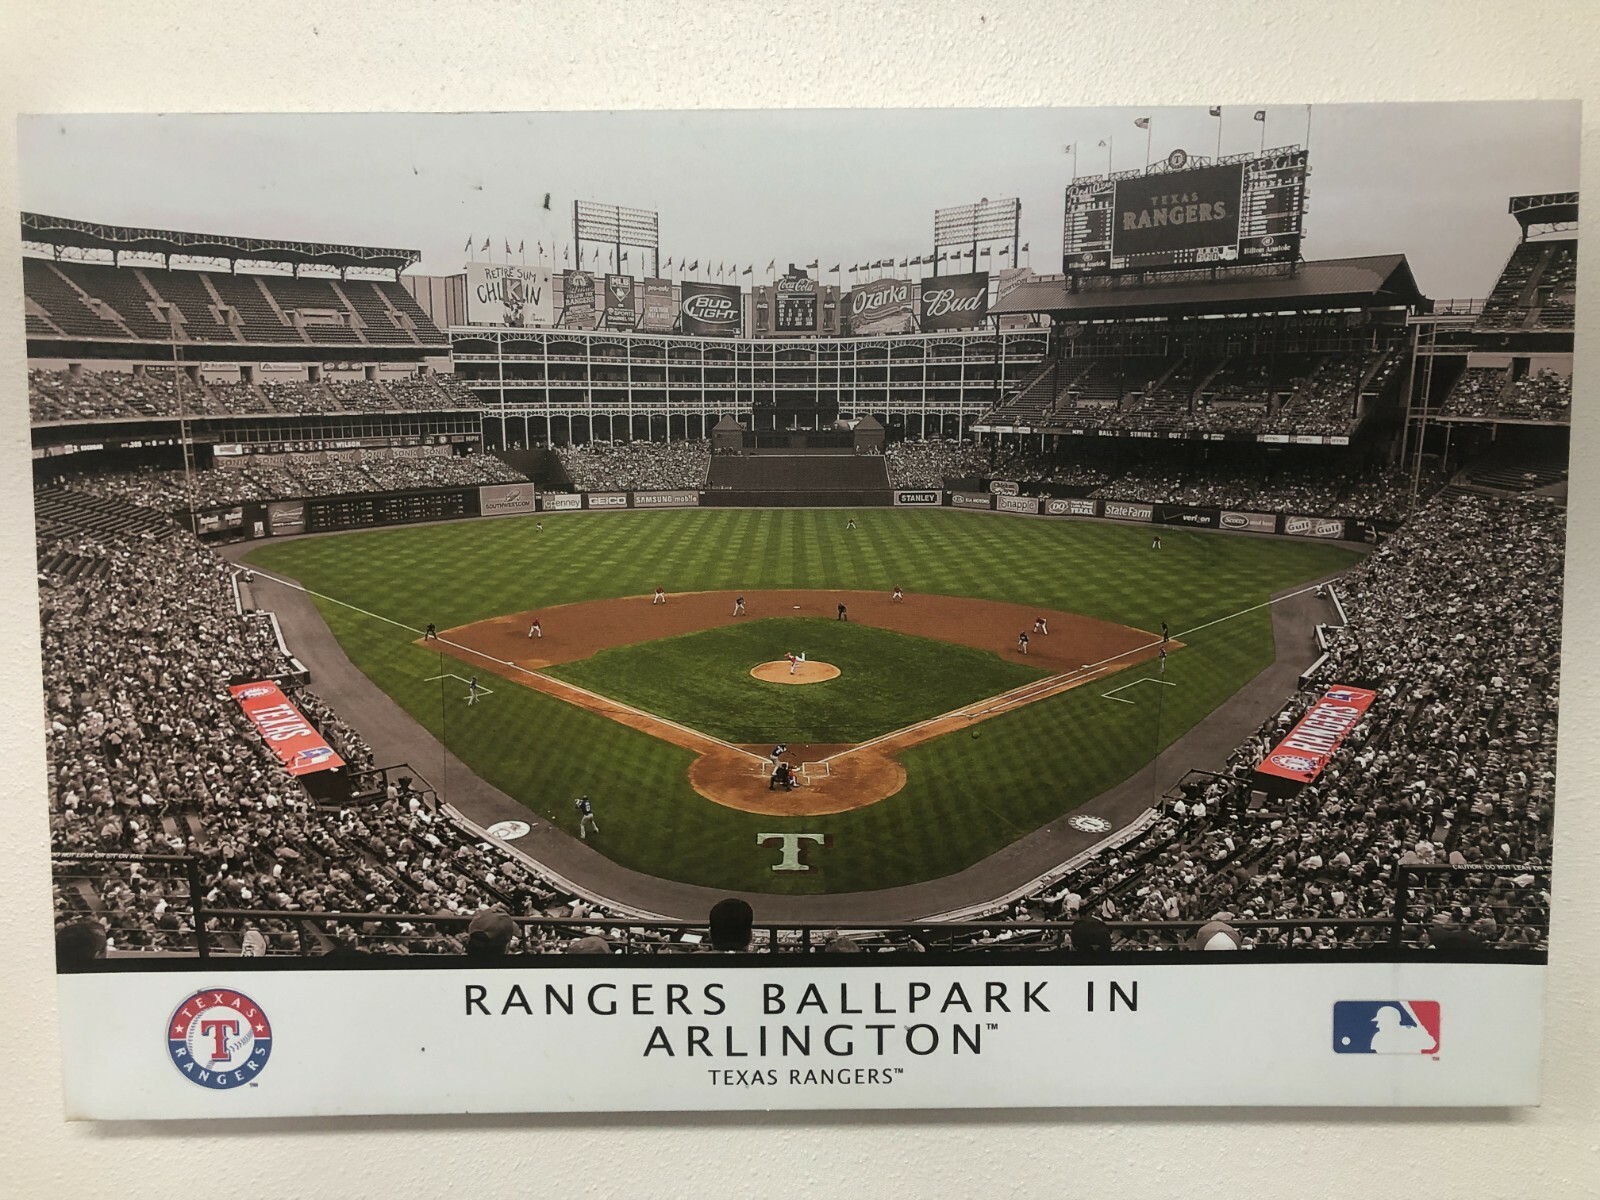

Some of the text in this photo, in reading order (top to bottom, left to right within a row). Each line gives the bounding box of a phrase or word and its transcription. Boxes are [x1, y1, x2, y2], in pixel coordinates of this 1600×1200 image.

[1151, 192, 1199, 206] TEXAS
[1123, 201, 1226, 231] RANGERS
[485, 267, 536, 283] RETIRE SUM
[695, 297, 732, 309] BUD
[853, 285, 907, 314] Ozarka
[923, 287, 986, 317] Bud
[689, 306, 738, 319] LIGHT
[336, 441, 361, 449] WILSON
[589, 497, 626, 505] GEICO
[636, 494, 697, 504] SAMSUNG mobile
[901, 494, 935, 502] STANLEY
[1001, 499, 1034, 511] Snapple
[1052, 503, 1066, 511] DQ
[1287, 522, 1310, 532] Gulf
[1317, 524, 1340, 535] Gulf
[251, 704, 312, 741] TEXAS
[1283, 702, 1359, 755] RANGERS
[756, 832, 828, 873] T
[182, 993, 257, 1018] TEXAS
[466, 981, 1138, 1016] RANGERS BALLPARK IN
[201, 1020, 240, 1062] T
[175, 1046, 266, 1085] RANGERS
[708, 1069, 778, 1085] TEXAS
